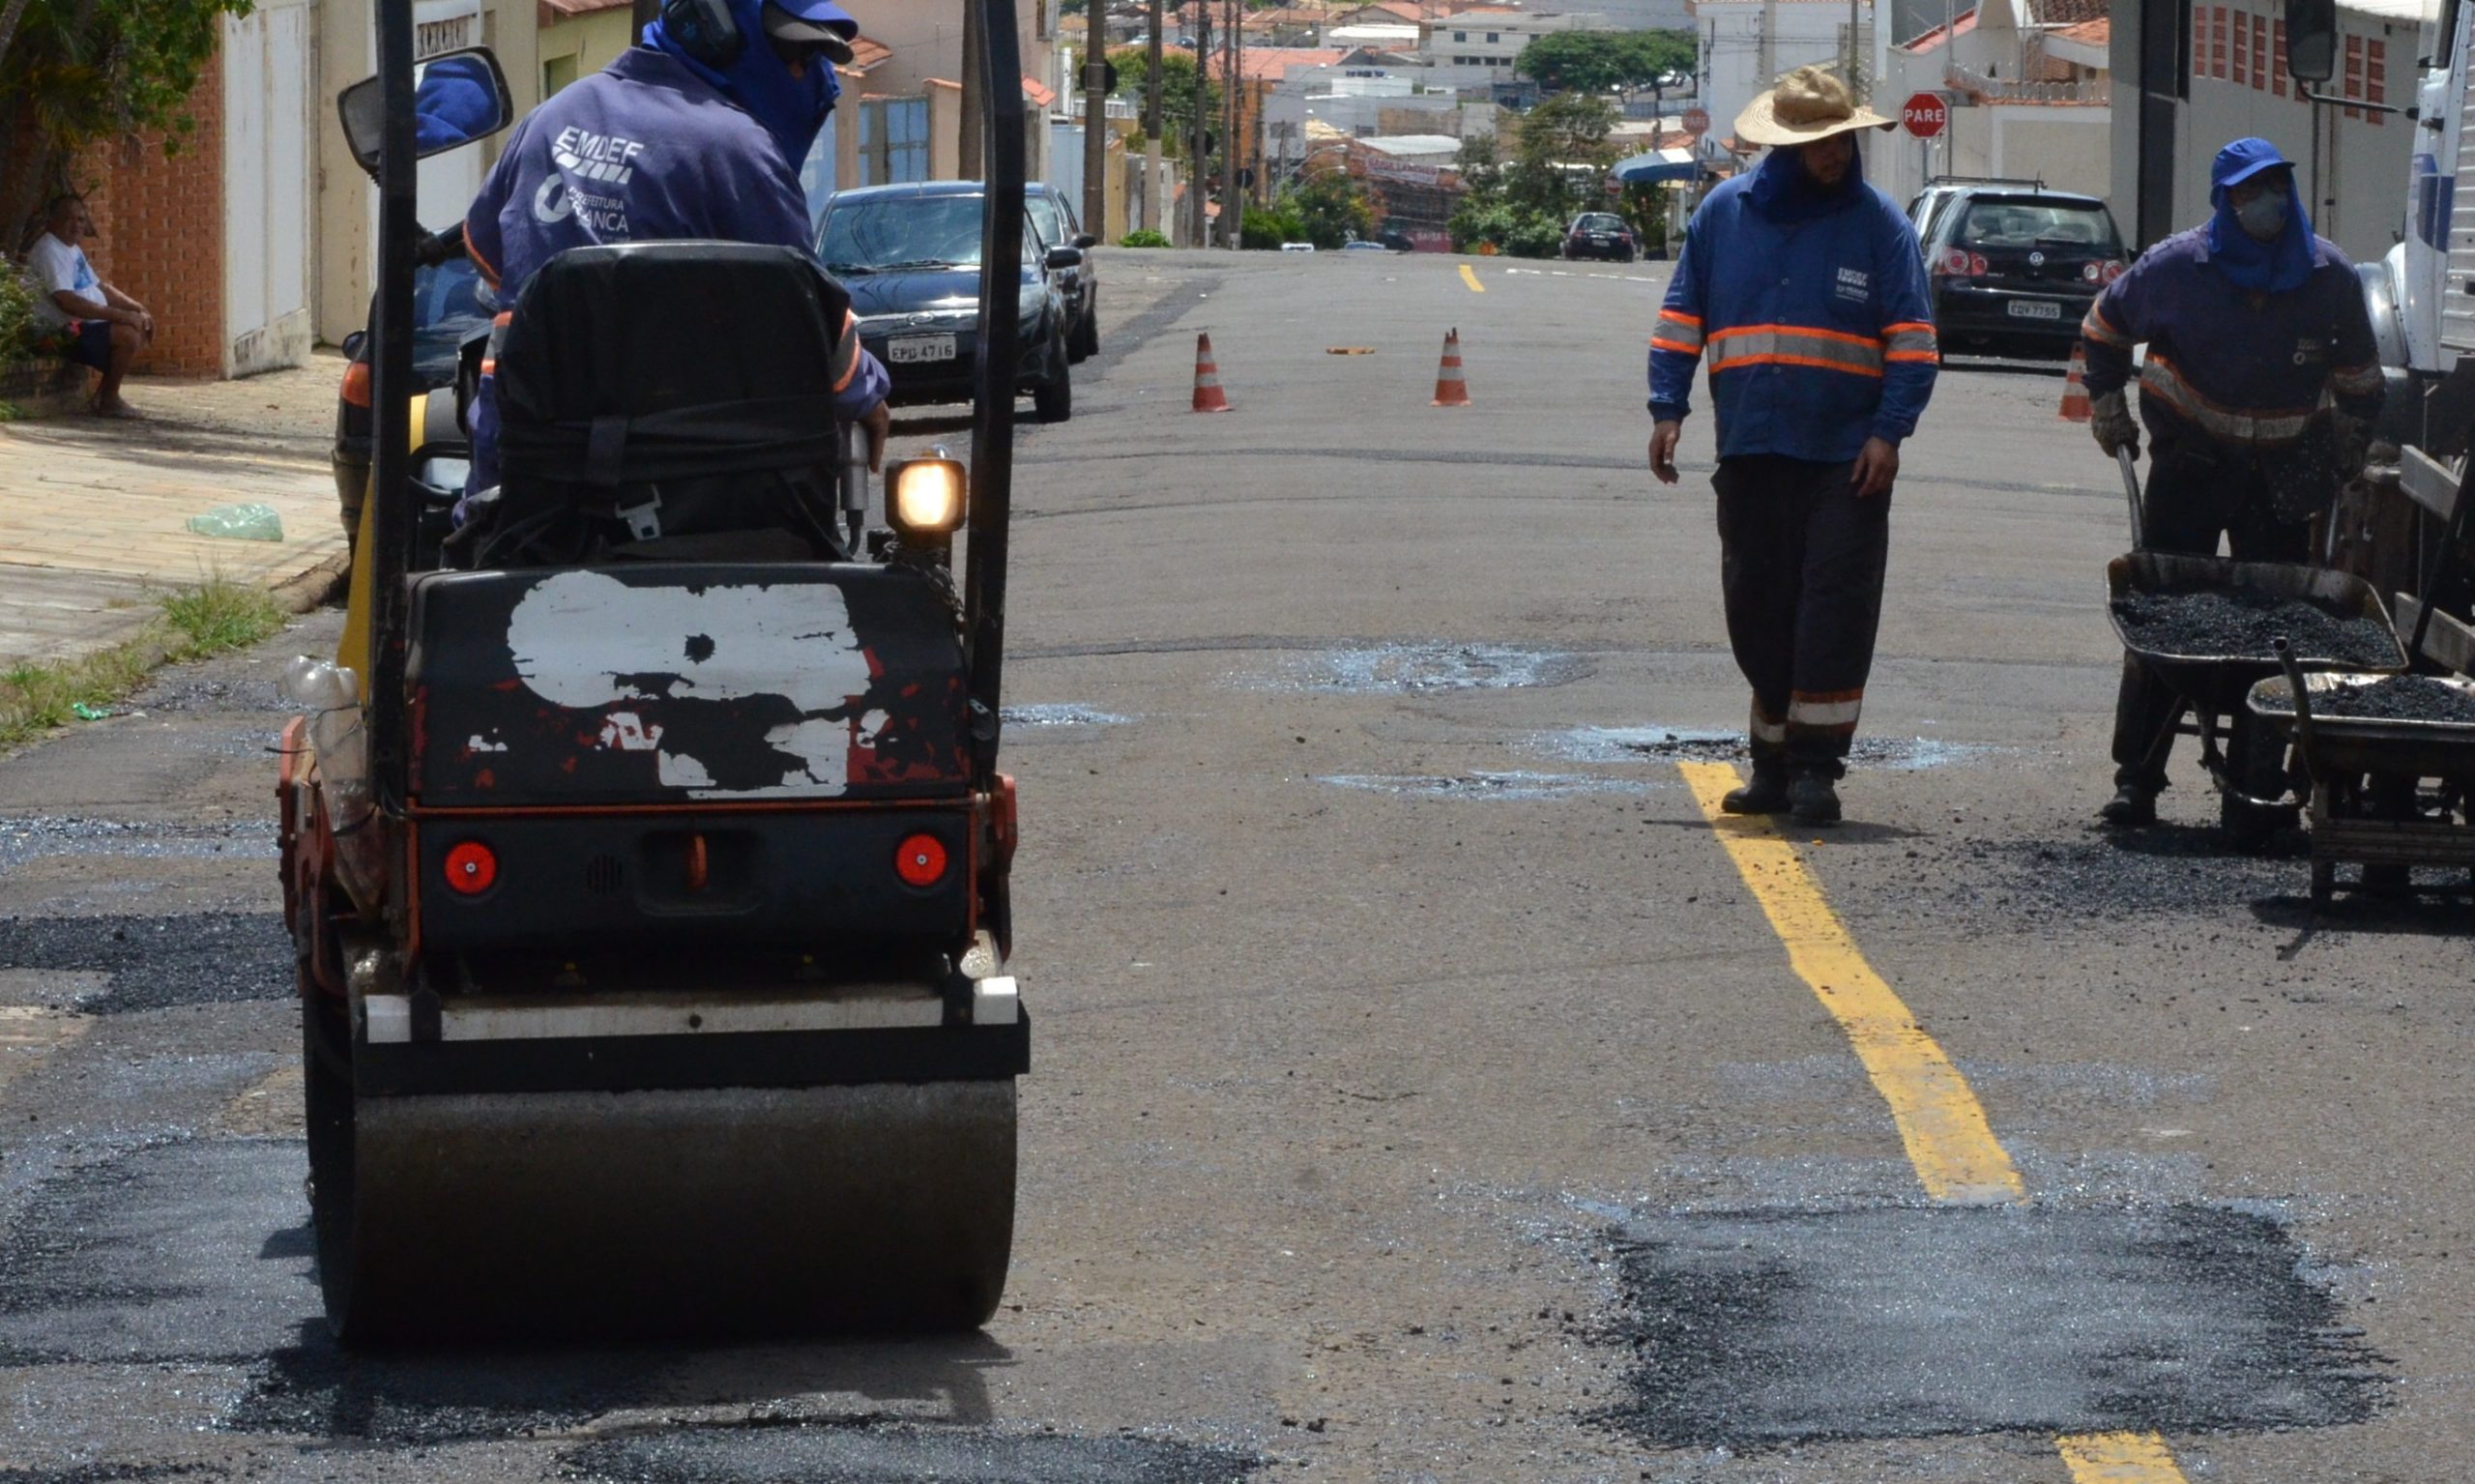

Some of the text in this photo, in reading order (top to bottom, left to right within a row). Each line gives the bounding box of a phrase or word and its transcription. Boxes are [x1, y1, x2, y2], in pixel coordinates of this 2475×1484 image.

[1905, 108, 1944, 123] PARE
[556, 126, 645, 164] EMDEF
[568, 186, 625, 211] PREFEITURA
